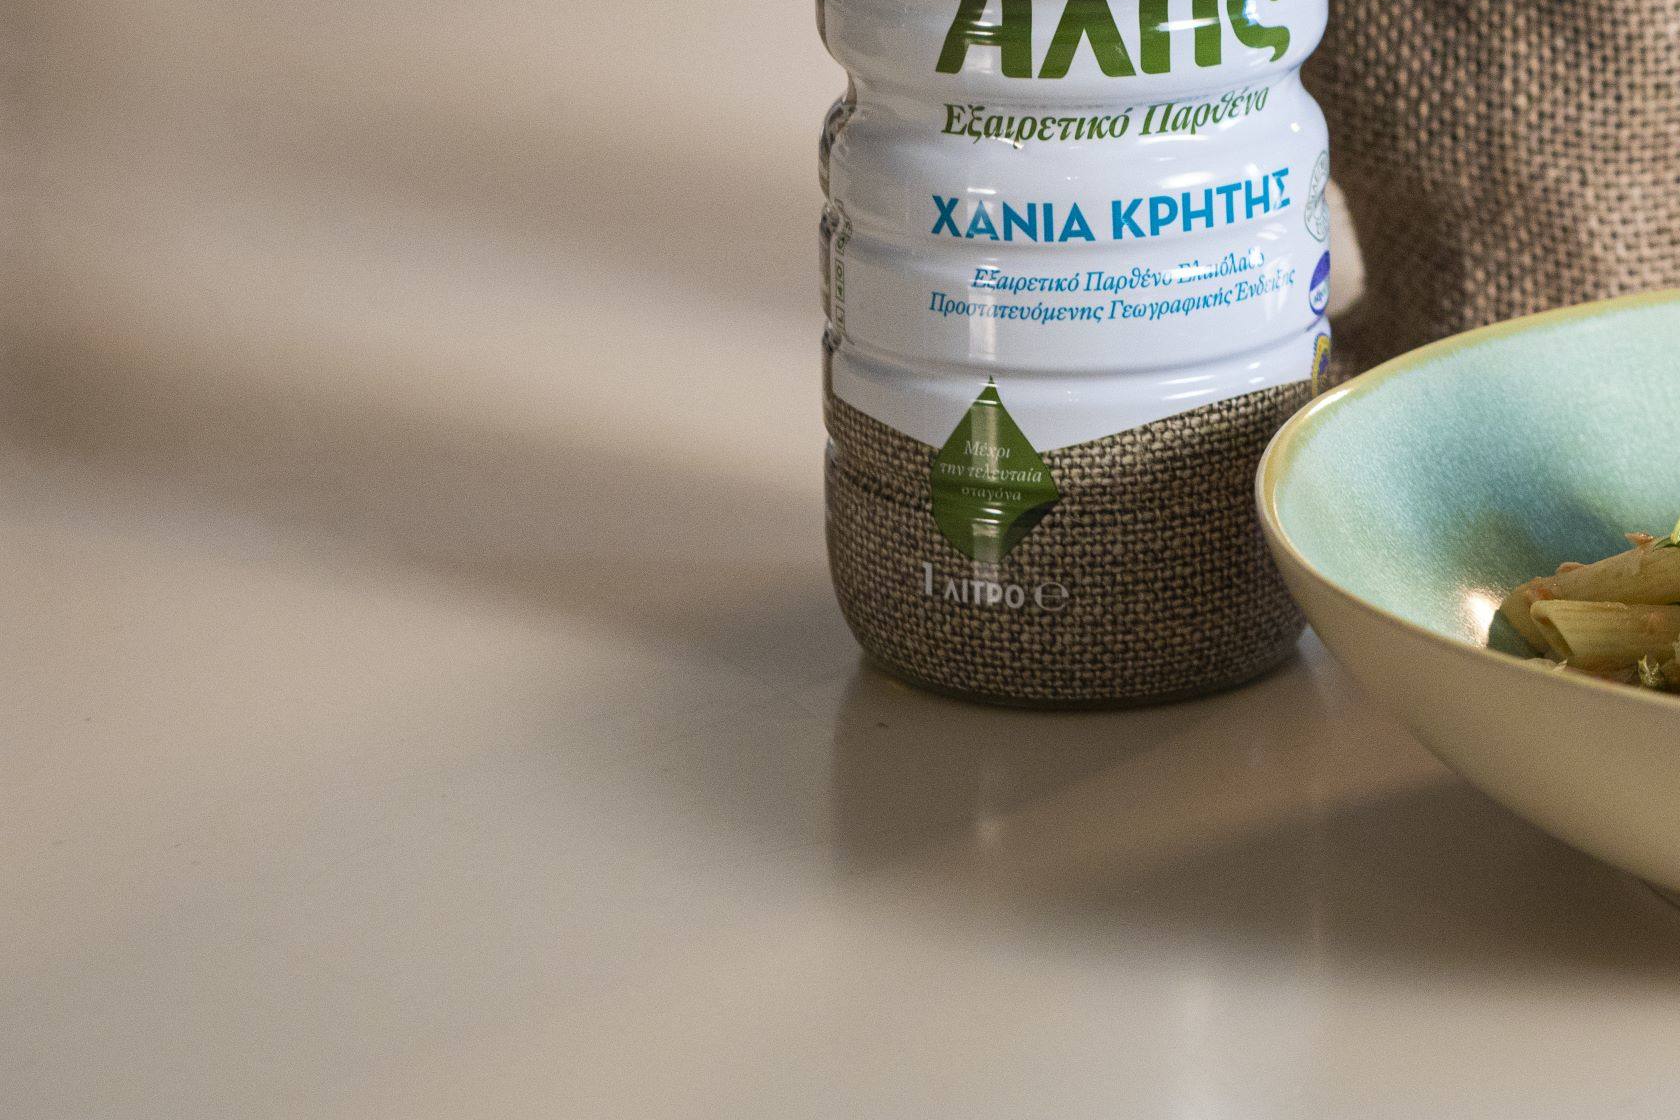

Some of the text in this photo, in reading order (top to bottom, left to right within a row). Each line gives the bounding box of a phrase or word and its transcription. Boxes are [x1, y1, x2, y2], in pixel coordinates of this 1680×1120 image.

[941, 86, 1270, 150] Εξαιρετικό Παρθένο
[931, 194, 1096, 243] ΧΑΝΙΑ
[1111, 167, 1291, 241] ΚΡΗΤΗΣ
[971, 267, 1079, 295] Εξαιρετικό
[1083, 267, 1173, 295] Παρθένο
[929, 290, 1105, 325] Προστατευόμενης
[1108, 286, 1233, 321] Γεωγραφικής
[939, 462, 1043, 483] την τελευταία
[961, 486, 1022, 502] σταγόνα
[922, 561, 934, 596] 1
[943, 577, 1026, 610] ΛΙΤΡΟ
